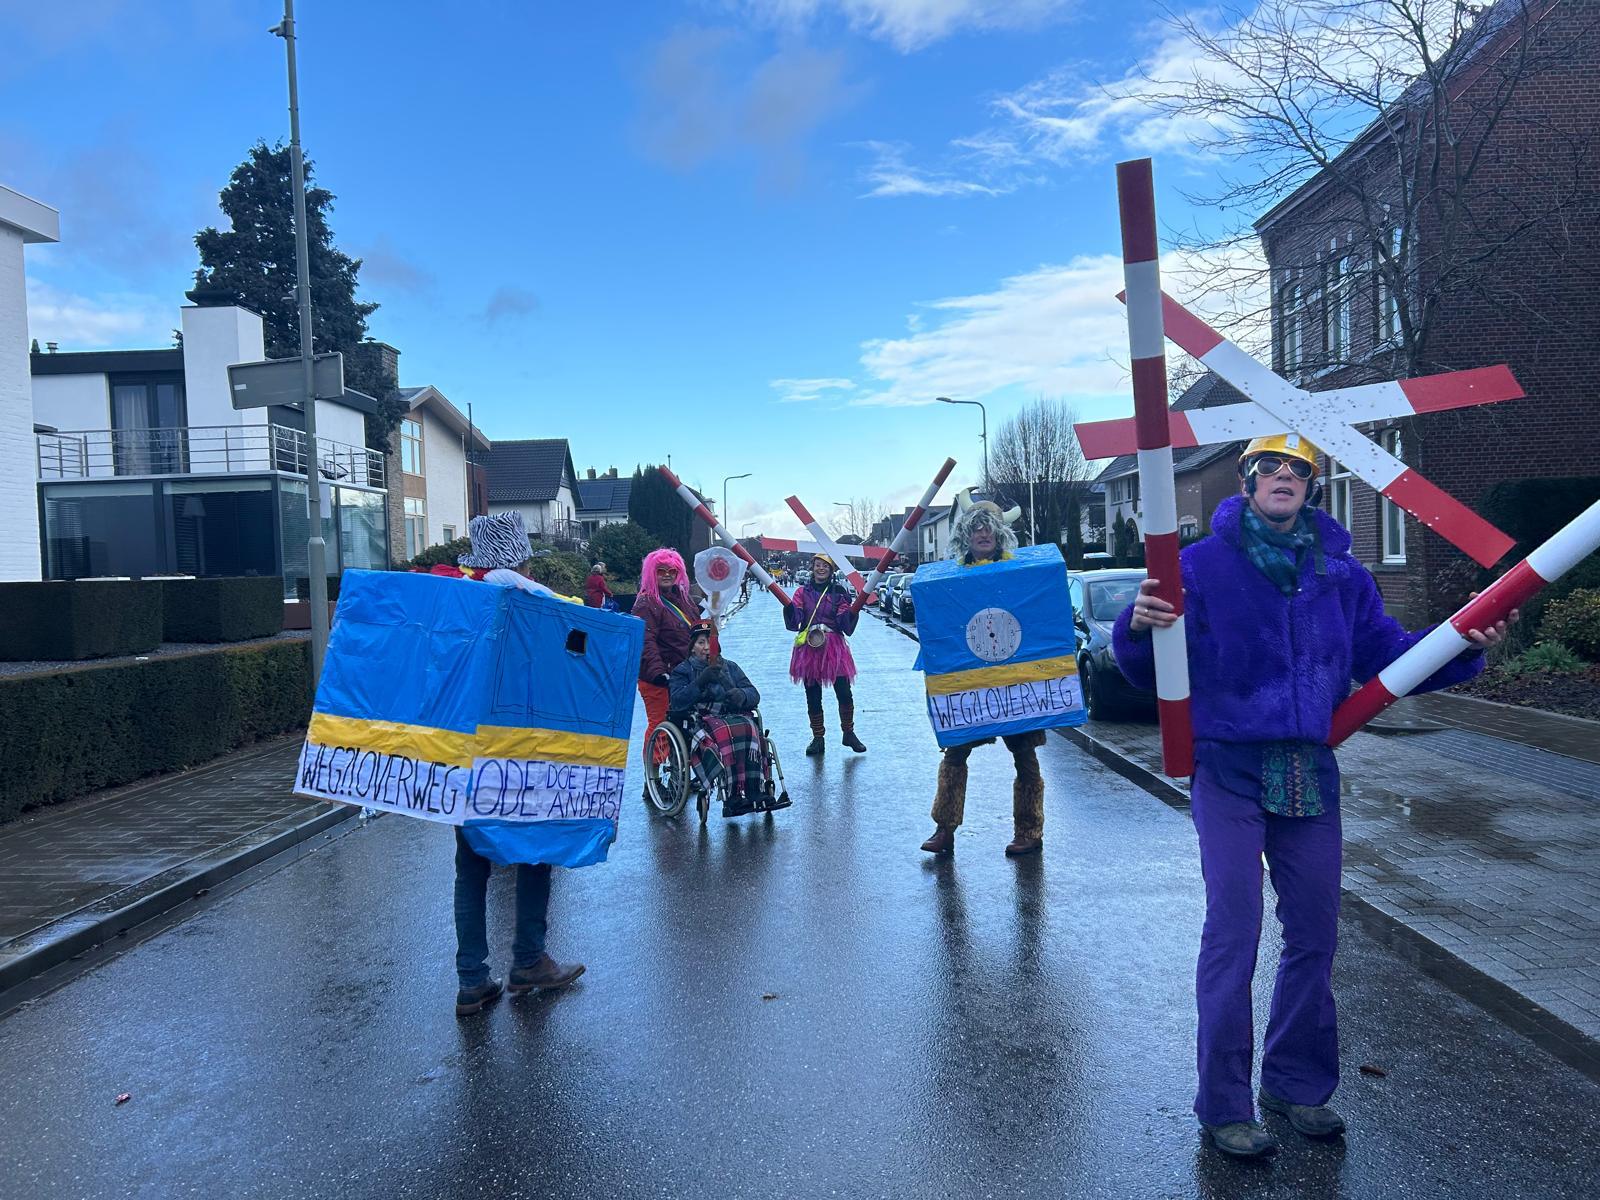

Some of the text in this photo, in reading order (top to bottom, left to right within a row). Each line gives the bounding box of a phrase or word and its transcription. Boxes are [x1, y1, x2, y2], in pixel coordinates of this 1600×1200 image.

[473, 758, 546, 816] ODE
[546, 763, 624, 791] DOET HET
